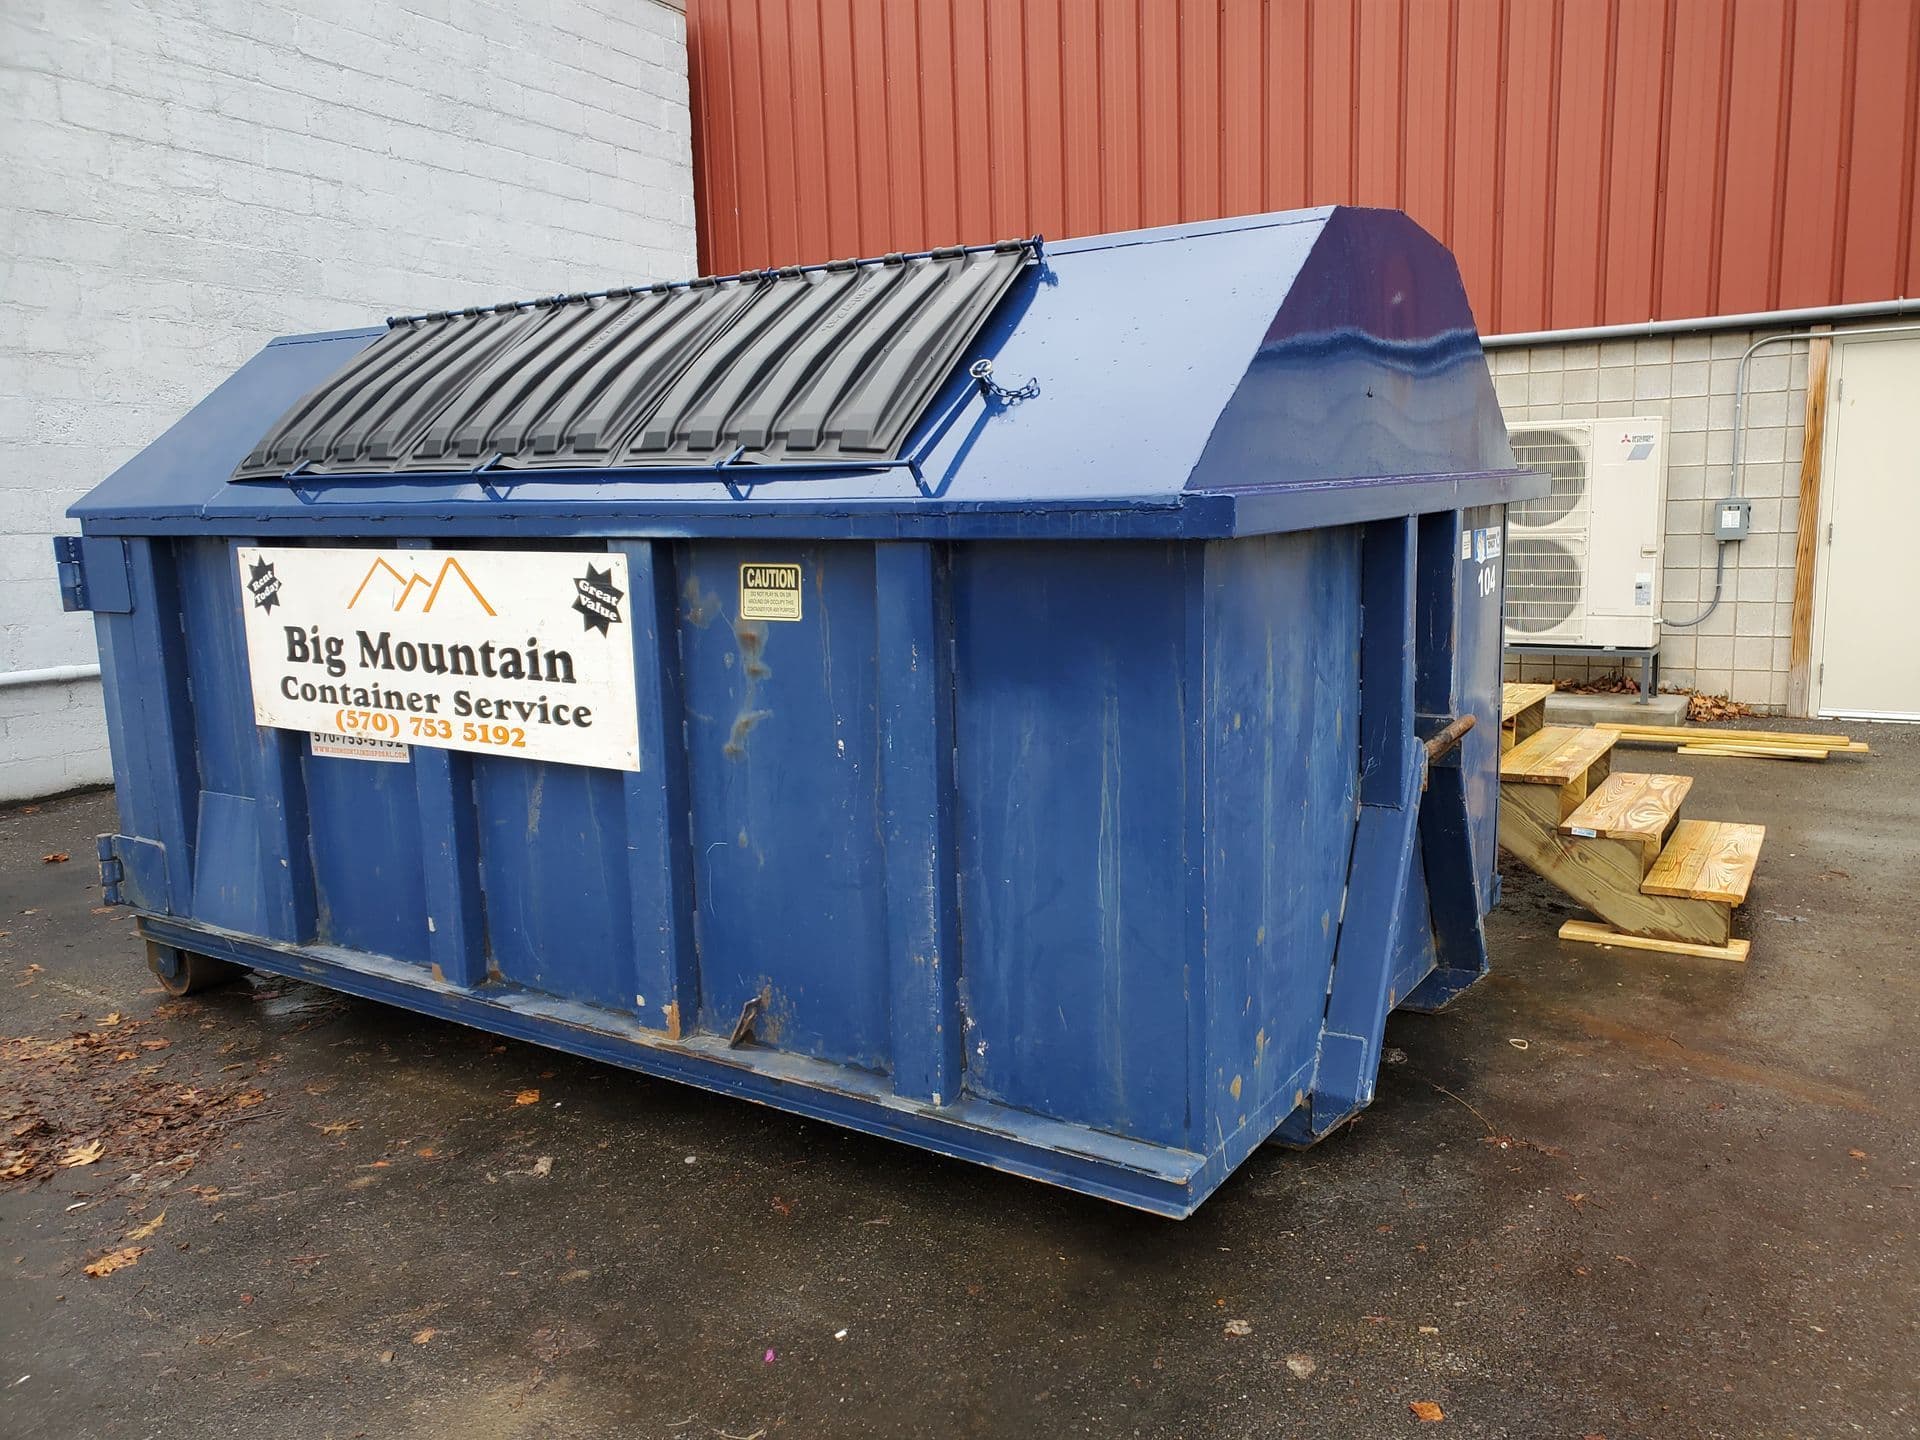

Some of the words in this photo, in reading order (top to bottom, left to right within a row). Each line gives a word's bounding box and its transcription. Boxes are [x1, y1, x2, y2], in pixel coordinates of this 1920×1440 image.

[252, 570, 273, 591] Rent
[255, 581, 280, 603] Today
[747, 568, 796, 588] CAUTION
[1477, 564, 1496, 598] 104
[579, 580, 618, 607] Great
[579, 593, 618, 621] Value
[284, 625, 346, 677] Big
[355, 630, 577, 684] Mountain
[281, 676, 441, 714] Container
[453, 690, 593, 728] Service
[335, 709, 400, 738] (570)
[410, 716, 453, 739] 753
[463, 722, 527, 748] 5192
